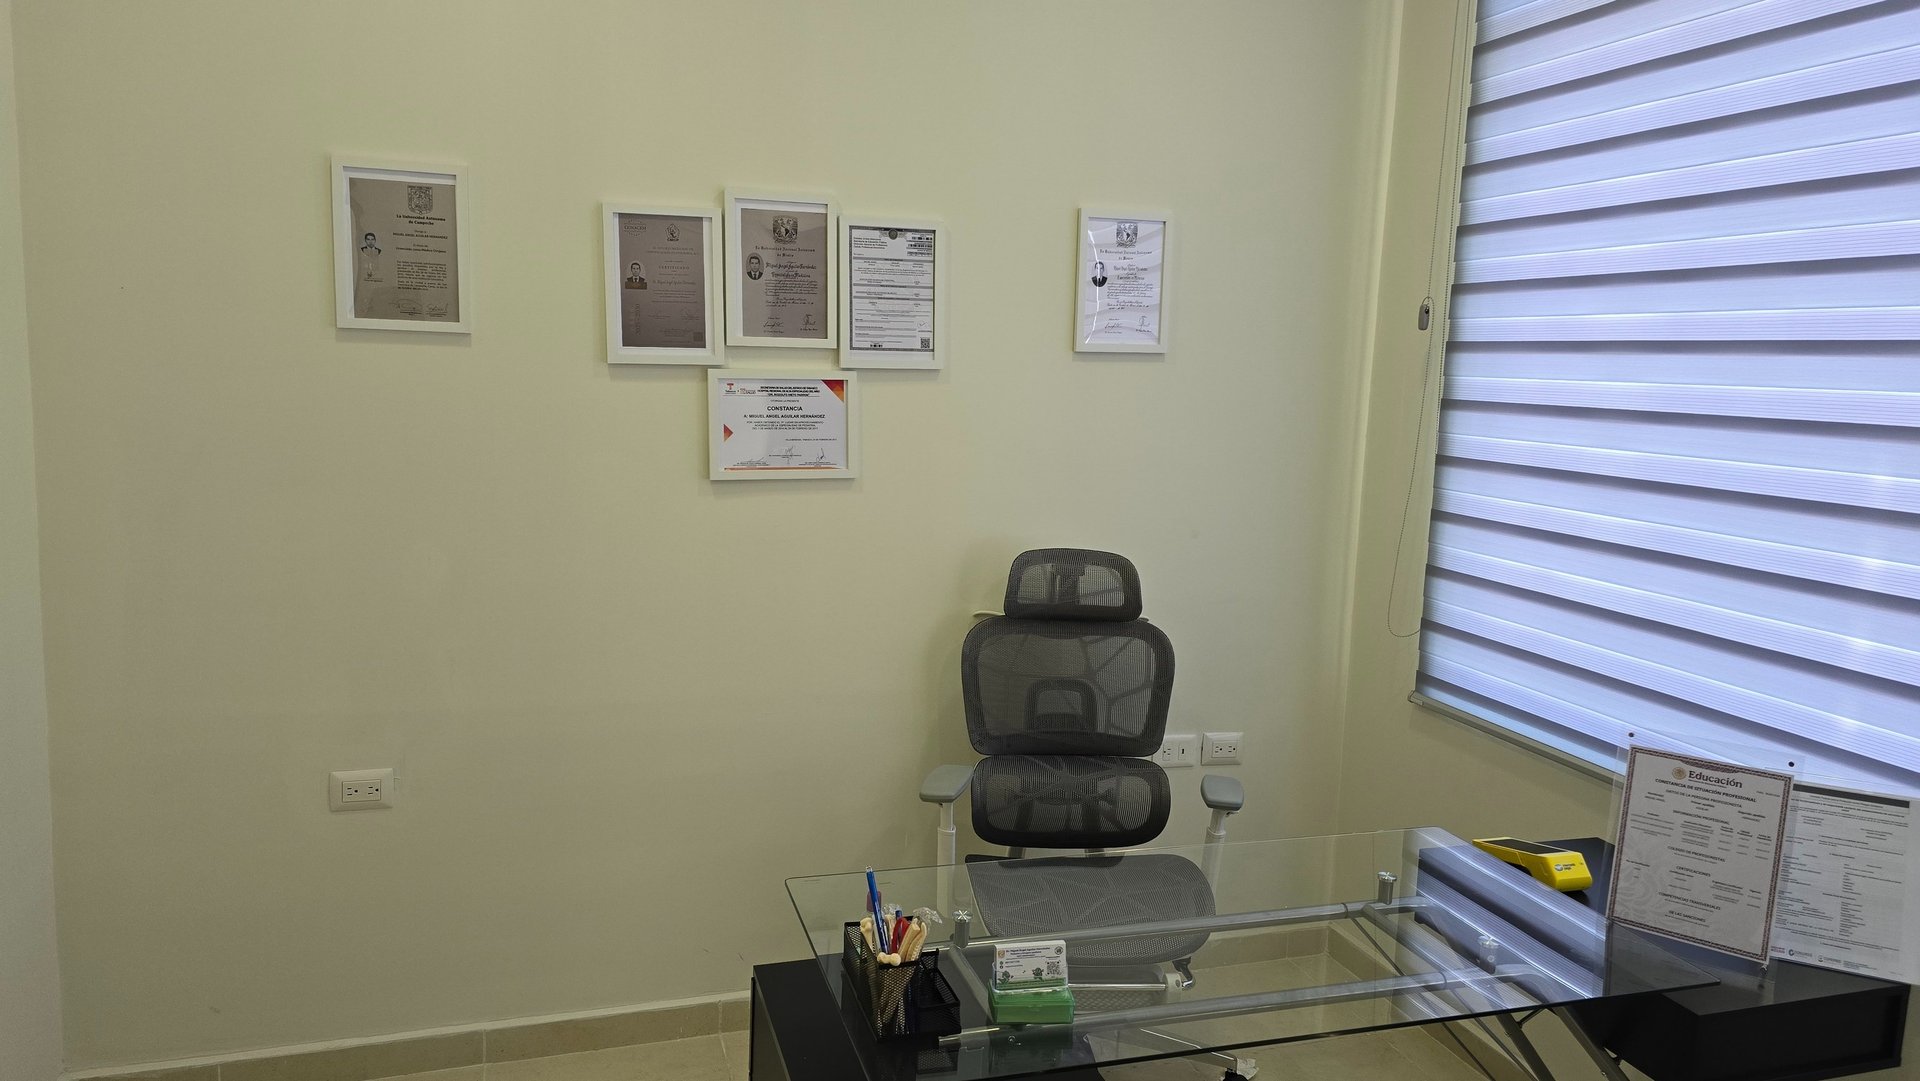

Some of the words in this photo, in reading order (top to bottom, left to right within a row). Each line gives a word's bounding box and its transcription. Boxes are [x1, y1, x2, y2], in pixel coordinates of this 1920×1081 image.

[1688, 770, 1743, 788] Educación
[1655, 778, 1687, 788] CONSTANCIA
[1694, 786, 1722, 796] SITUACIÓN
[1722, 791, 1757, 803] PROFESIONAL
